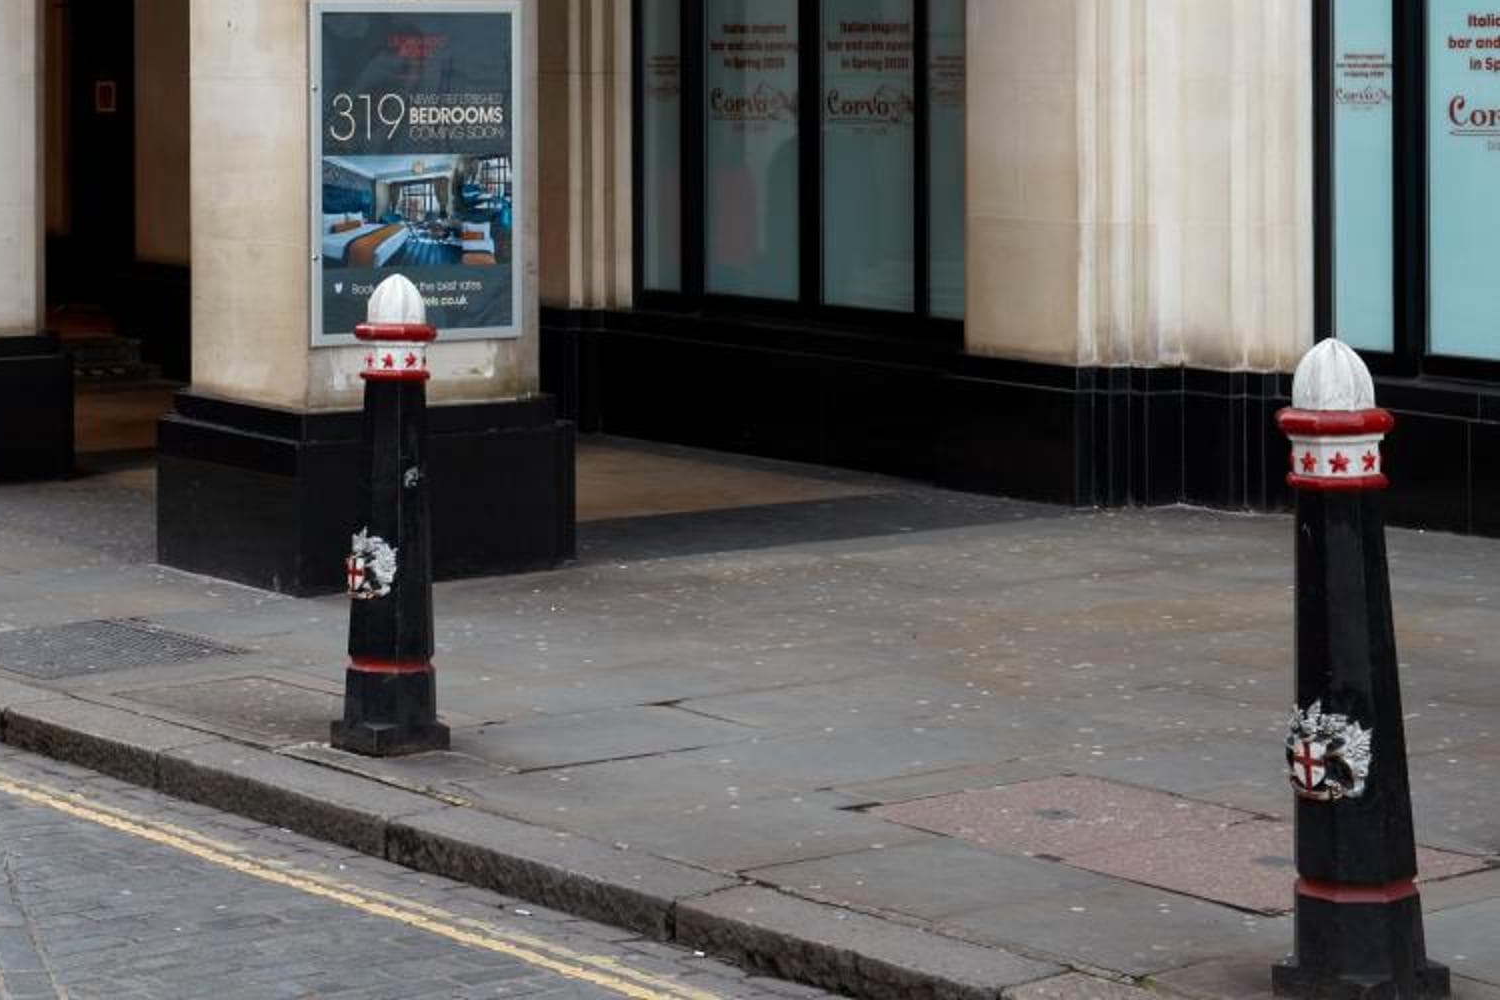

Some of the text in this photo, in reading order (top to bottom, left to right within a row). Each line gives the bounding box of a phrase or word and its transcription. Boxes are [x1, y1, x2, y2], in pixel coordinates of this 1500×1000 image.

[1449, 35, 1473, 49] bar
[1470, 57, 1500, 72] in Sp
[827, 88, 890, 115] Corvo
[1449, 96, 1500, 127] Cor
[330, 92, 405, 143] 319
[409, 105, 504, 125] BEDROOMS
